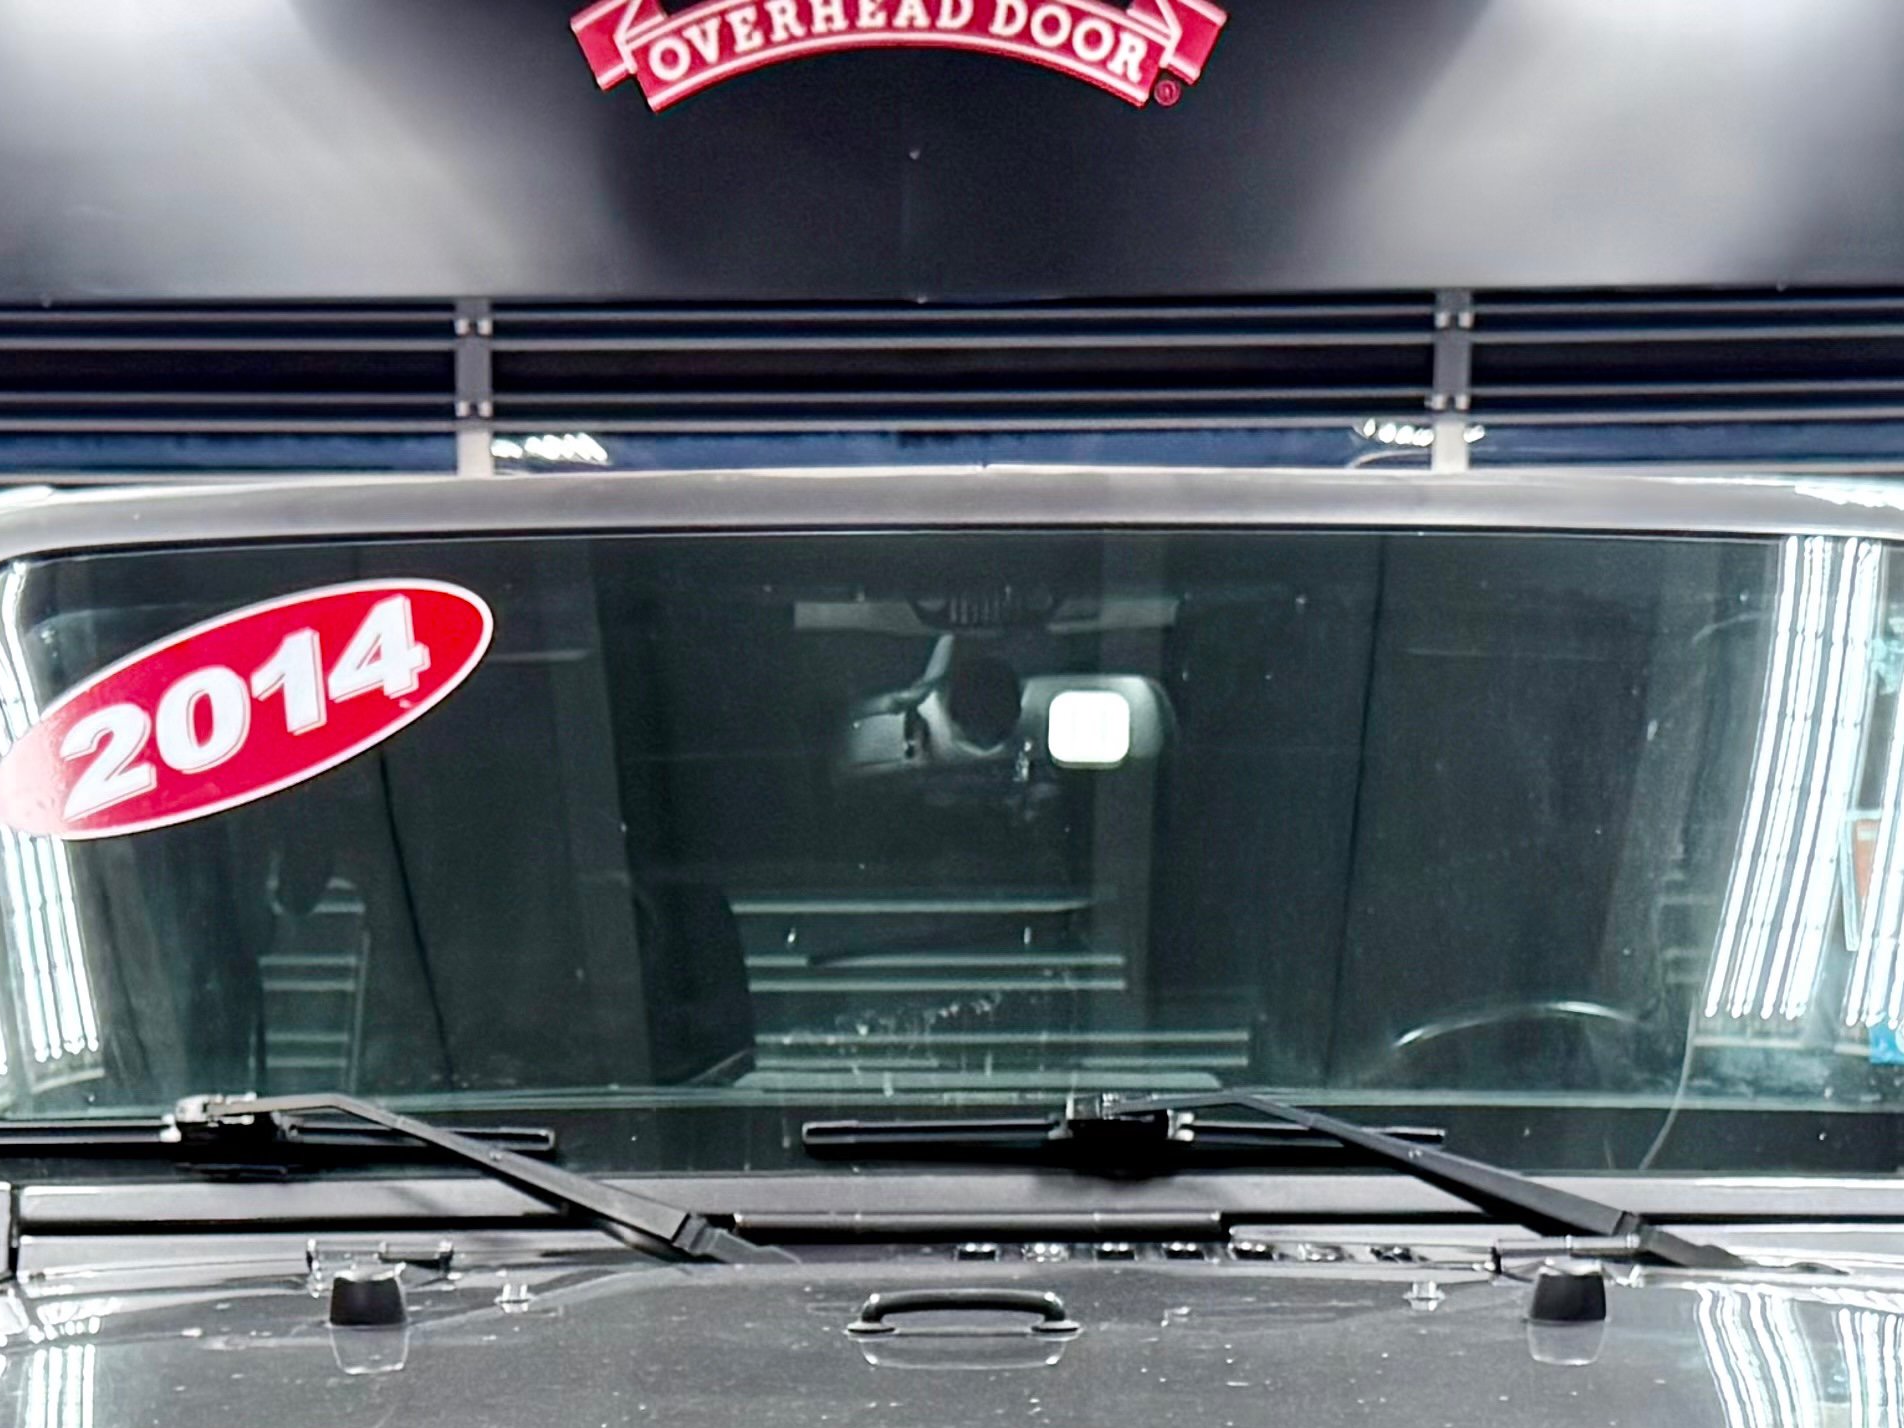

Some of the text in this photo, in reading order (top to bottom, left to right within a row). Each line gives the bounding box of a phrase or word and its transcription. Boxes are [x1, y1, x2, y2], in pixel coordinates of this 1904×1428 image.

[648, 0, 1147, 84] OVERHEAD DOOR
[59, 593, 431, 823] 2014
